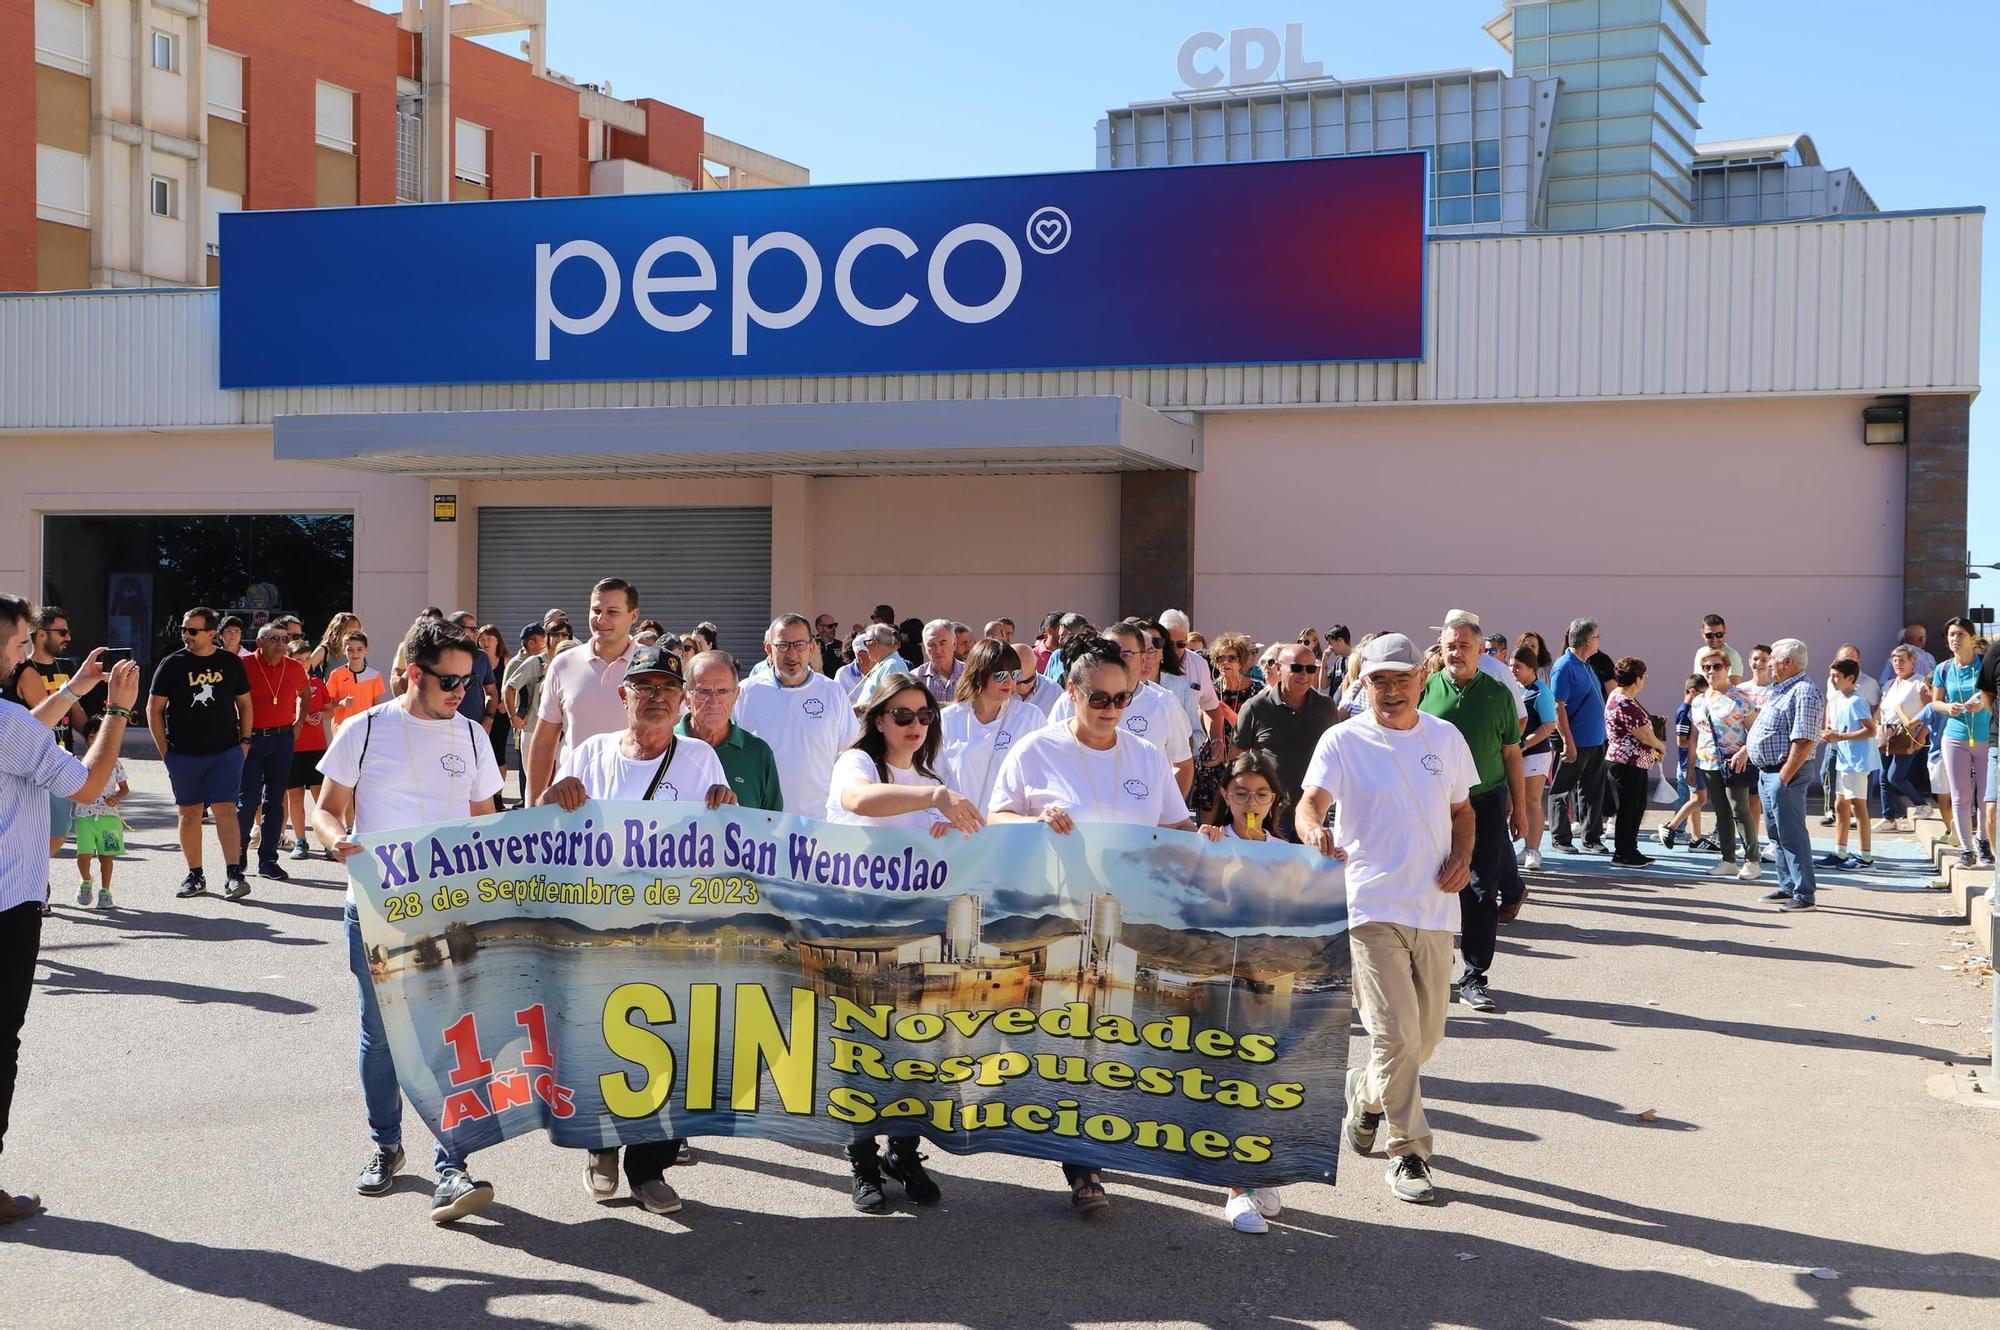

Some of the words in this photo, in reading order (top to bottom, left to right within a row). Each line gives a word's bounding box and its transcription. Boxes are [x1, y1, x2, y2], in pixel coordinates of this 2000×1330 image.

[1177, 22, 1324, 89] CDL
[535, 222, 1023, 361] pepco
[187, 668, 223, 686] Lois
[375, 840, 420, 890] XI
[428, 817, 613, 879] Aniversario
[623, 818, 715, 869] Riada
[723, 822, 778, 876] San
[788, 832, 948, 892] Wenceslao
[385, 891, 424, 923] 28
[431, 885, 470, 913] de
[478, 874, 635, 906] Septiembre
[644, 878, 680, 905] de
[689, 877, 760, 905] 2023
[599, 982, 818, 1119] SIN
[828, 995, 1279, 1064] Novedades
[827, 1036, 1305, 1112] Respuestas
[826, 1086, 1273, 1164] Soluciones
